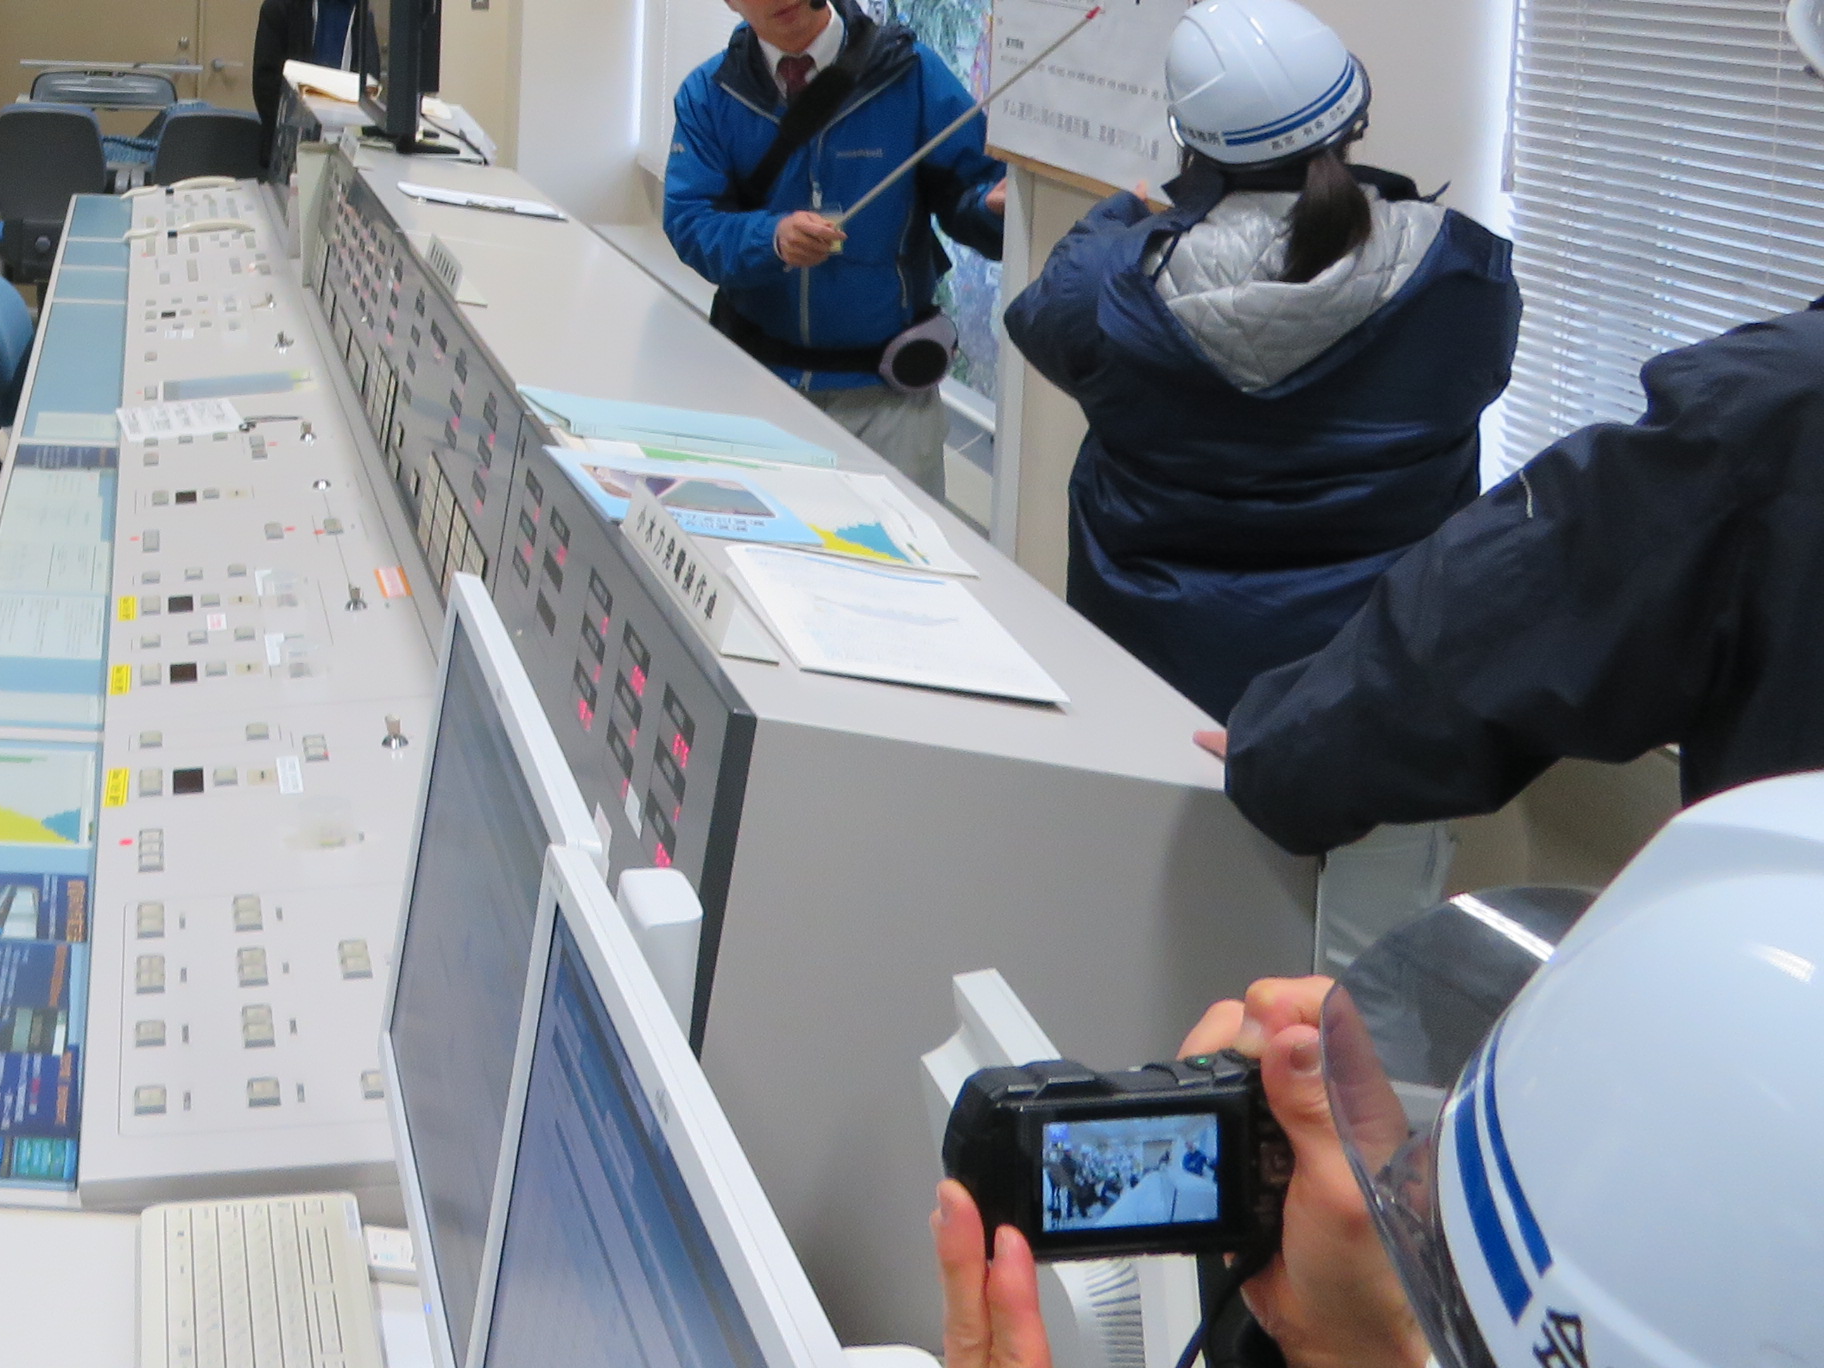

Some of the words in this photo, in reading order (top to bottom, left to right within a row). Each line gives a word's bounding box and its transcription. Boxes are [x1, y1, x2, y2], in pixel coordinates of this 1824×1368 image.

[636, 505, 718, 621] 小水力発電操作卓
